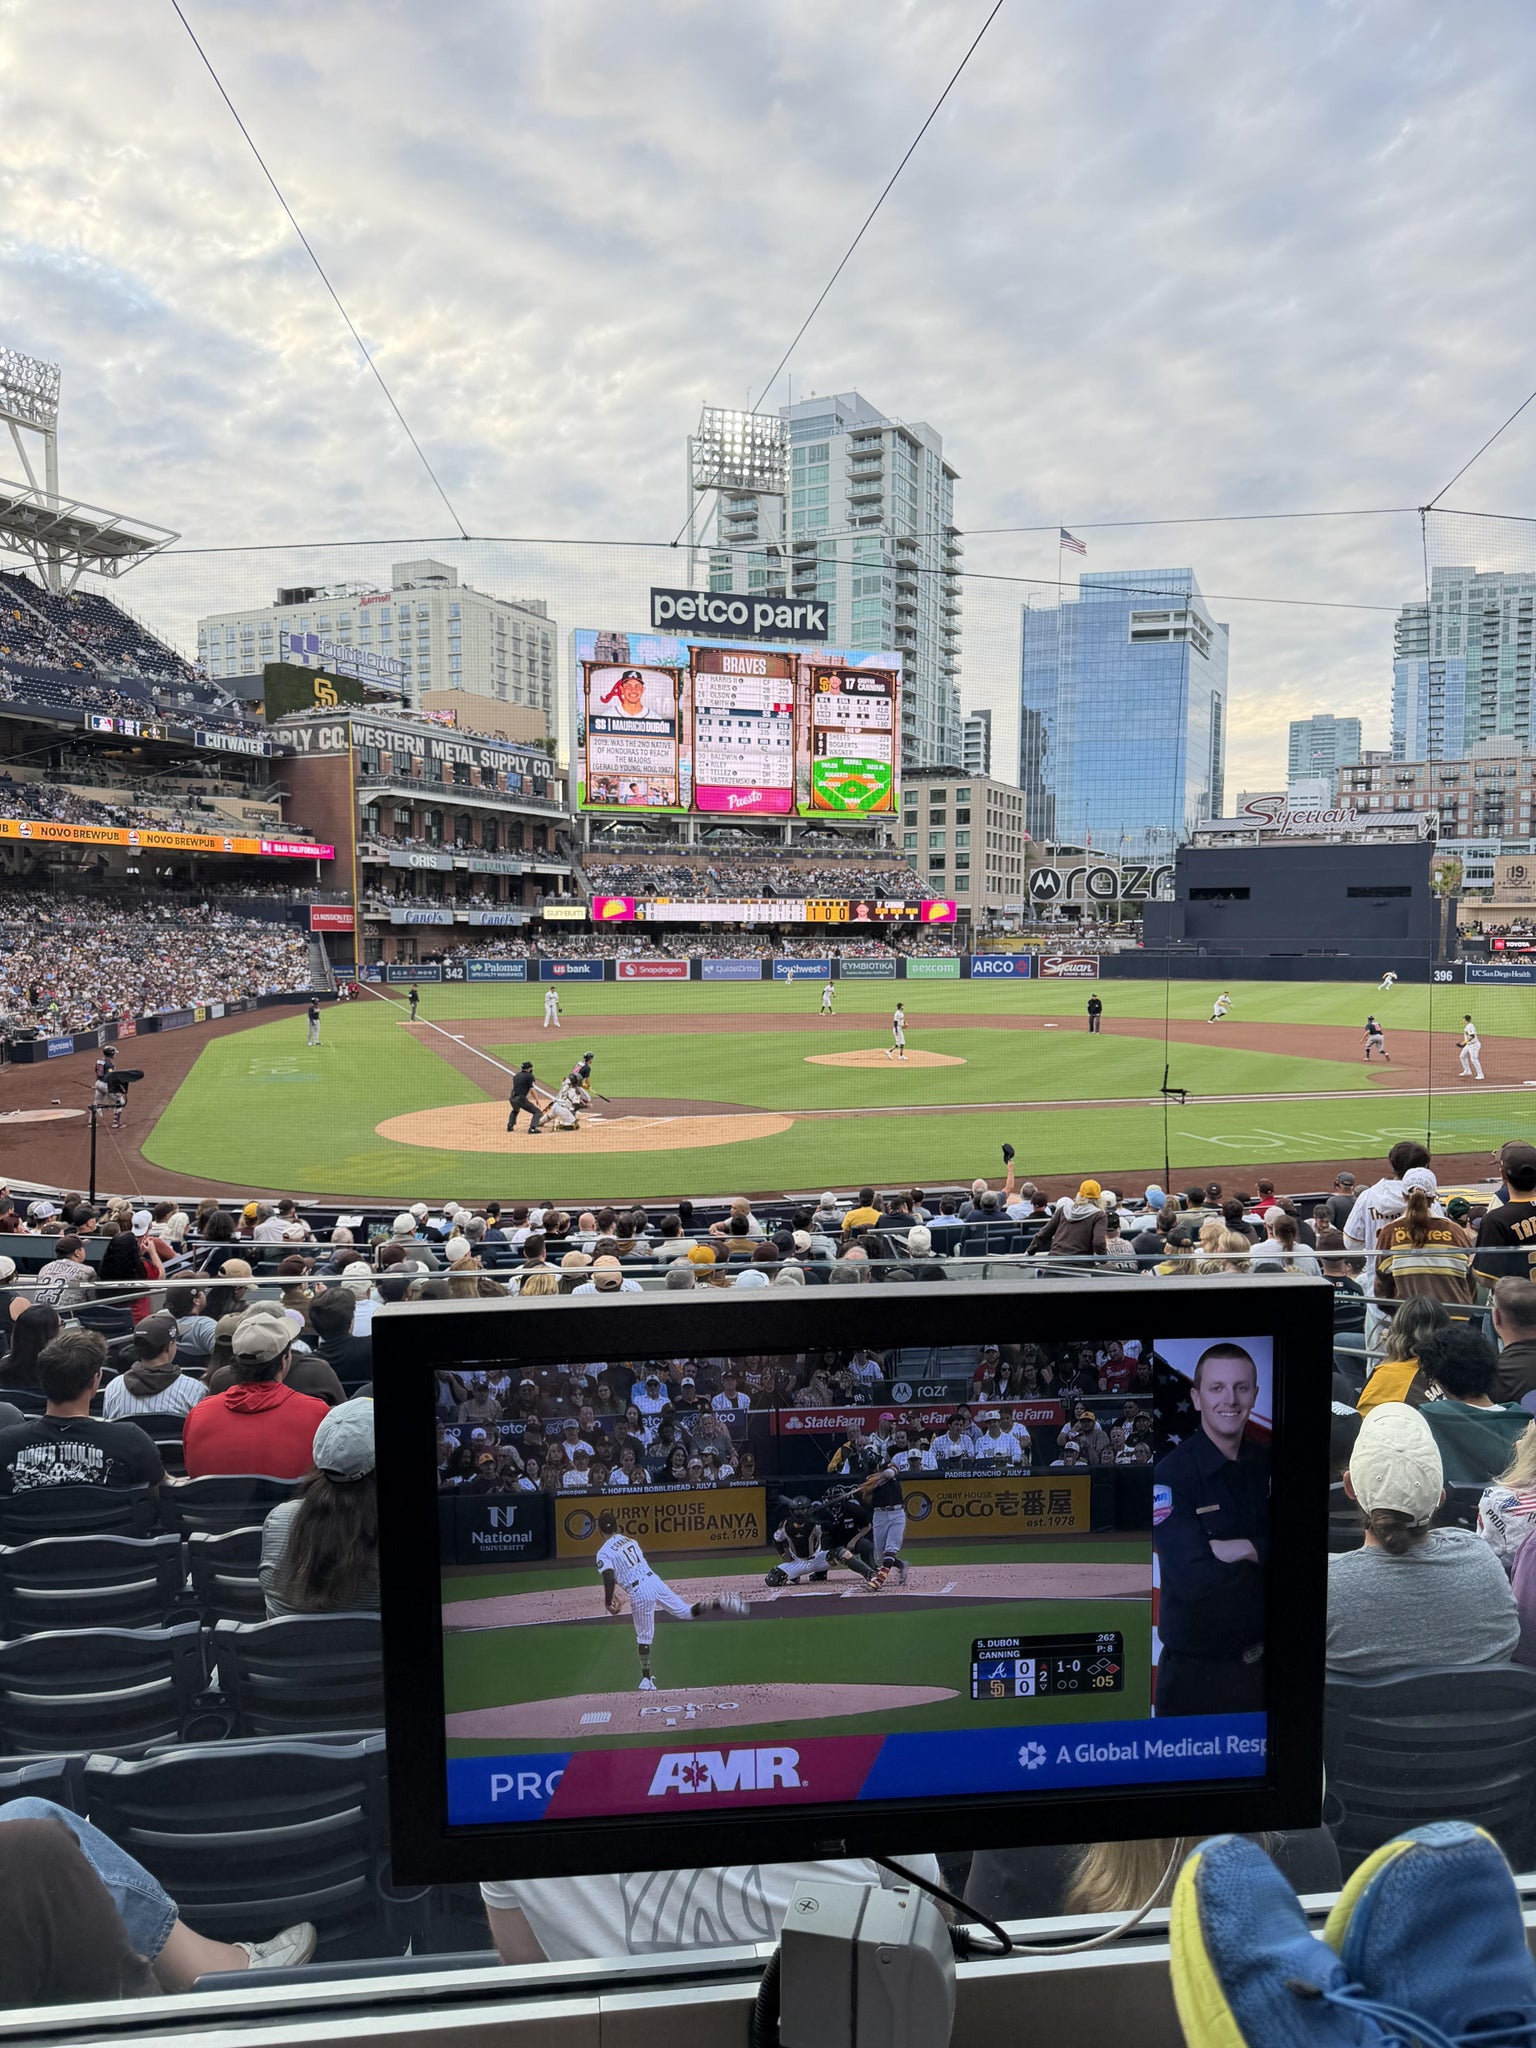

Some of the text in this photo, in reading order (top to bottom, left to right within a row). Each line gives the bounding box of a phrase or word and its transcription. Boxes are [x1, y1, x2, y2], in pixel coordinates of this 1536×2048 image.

[654, 593, 826, 634] petco park
[722, 655, 767, 675] BRAVES
[845, 677, 855, 690] 17
[710, 691, 730, 699] OLSON
[594, 718, 607, 730] SS
[205, 734, 264, 755] CUTWATER
[319, 726, 349, 750] CO.
[611, 739, 625, 747] WAS
[625, 739, 636, 747] THE
[651, 741, 672, 750] NATIVE
[352, 724, 554, 779] WESTERN METAL SUPPLY CO.
[606, 747, 640, 756] HONDURAS
[640, 748, 649, 756] TO
[649, 749, 669, 757] REACH
[710, 753, 738, 761] BALDWIN
[615, 755, 652, 764] THE MAJORS
[726, 790, 763, 809] Puesto
[1242, 796, 1359, 835] Sycuan
[41, 827, 119, 841] NOVO BREWPUB
[146, 834, 215, 848] NOVO BREWPUB
[408, 854, 437, 868] ORIS
[1511, 865, 1525, 878] 19
[1066, 865, 1176, 901] razr
[364, 924, 379, 935] 336
[484, 963, 524, 972] Palomar
[554, 964, 591, 974] us bank
[639, 965, 682, 975] Snapdragon
[716, 965, 759, 973] QuidelOrtho
[776, 964, 821, 974] Southwest
[973, 960, 1014, 973] ARCO
[1043, 957, 1093, 977] Sycuan
[445, 968, 464, 979] 342
[1434, 970, 1453, 981] 396
[1494, 970, 1511, 979] Diego
[1511, 970, 1532, 978] Health
[1176, 1127, 1456, 1149] blue
[917, 1385, 948, 1398] razr
[944, 1471, 971, 1479] PADRES
[972, 1470, 1001, 1478] PONCHO
[1006, 1469, 1023, 1477] JULY
[608, 1486, 644, 1495] HOFFMAN
[644, 1484, 691, 1493] BOBBLEHEAD
[936, 1491, 993, 1500] CURRY HOUSE
[936, 1488, 1073, 1518] CoCo 壱番屋
[654, 1502, 706, 1518] HOUSE
[654, 1513, 759, 1533] ICHIBANYA
[471, 1530, 533, 1544] National
[480, 1544, 525, 1552] UNIVERSITY
[622, 1544, 641, 1568] 17
[987, 1638, 1020, 1648] DUBÓN
[1095, 1634, 1115, 1643] .262
[979, 1650, 1021, 1660] CANNING
[1019, 1661, 1030, 1675] 0
[1057, 1659, 1081, 1673] 1-0
[1039, 1671, 1047, 1682] 2
[1092, 1675, 1114, 1687] :05
[1019, 1680, 1030, 1694] 0
[639, 1701, 740, 1717] petco
[1056, 1744, 1071, 1764] A
[1075, 1739, 1139, 1763] Global
[1144, 1736, 1221, 1760] Medical
[648, 1746, 801, 1796] AMR
